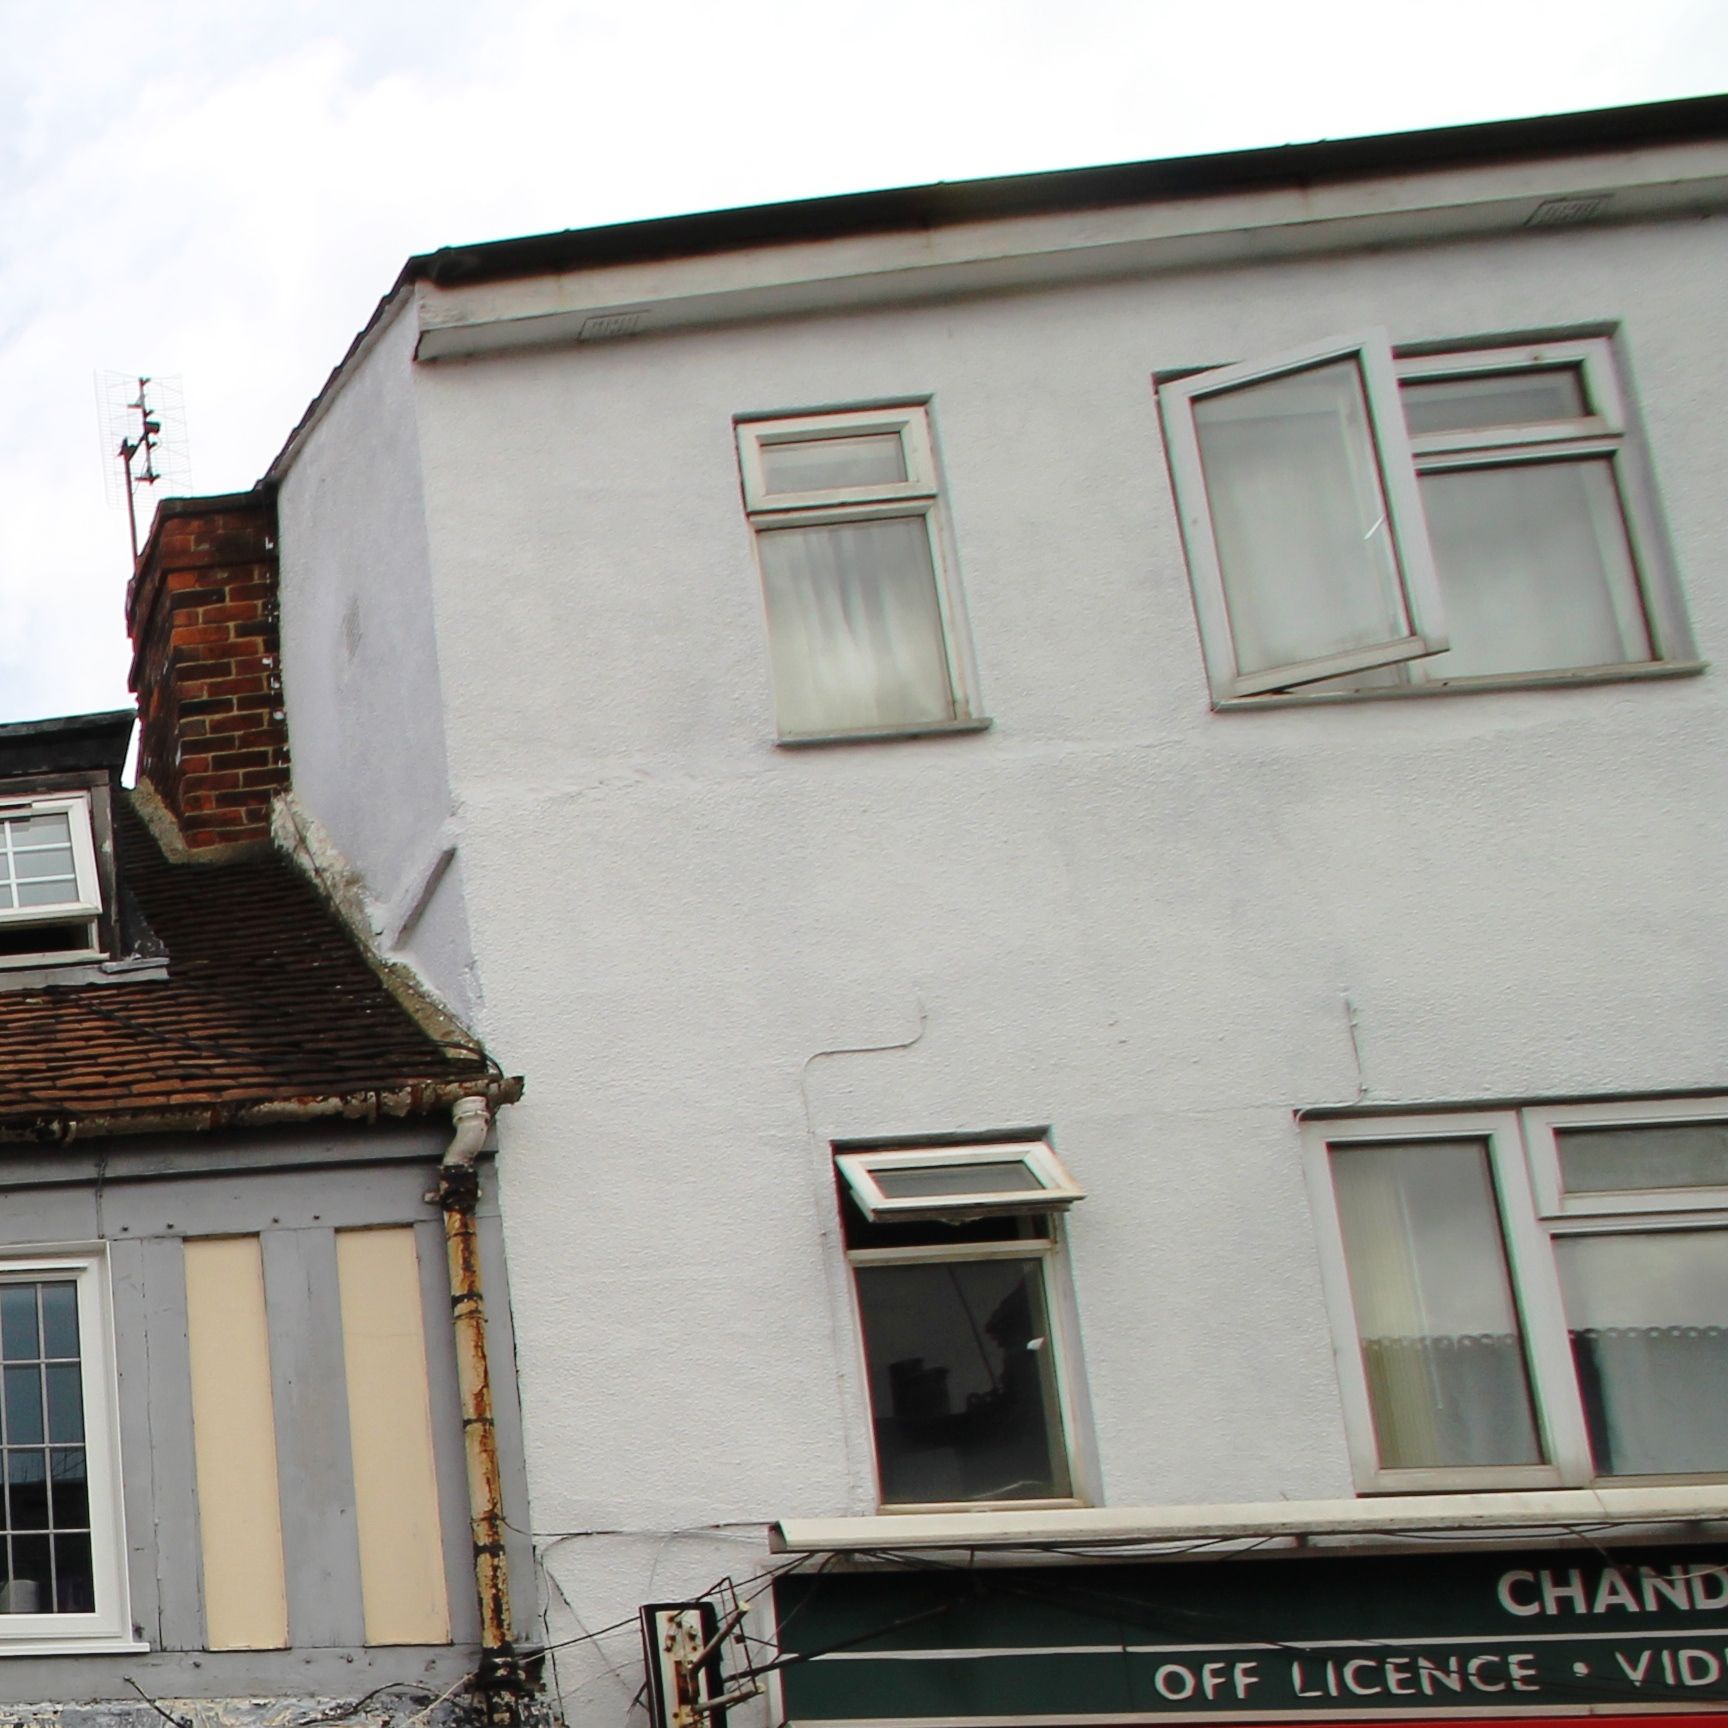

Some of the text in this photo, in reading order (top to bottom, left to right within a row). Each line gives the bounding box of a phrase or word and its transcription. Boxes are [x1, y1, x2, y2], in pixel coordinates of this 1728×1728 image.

[1496, 1564, 1728, 1617] CHAND
[1154, 1647, 1728, 1701] OFF LICENCE VID
